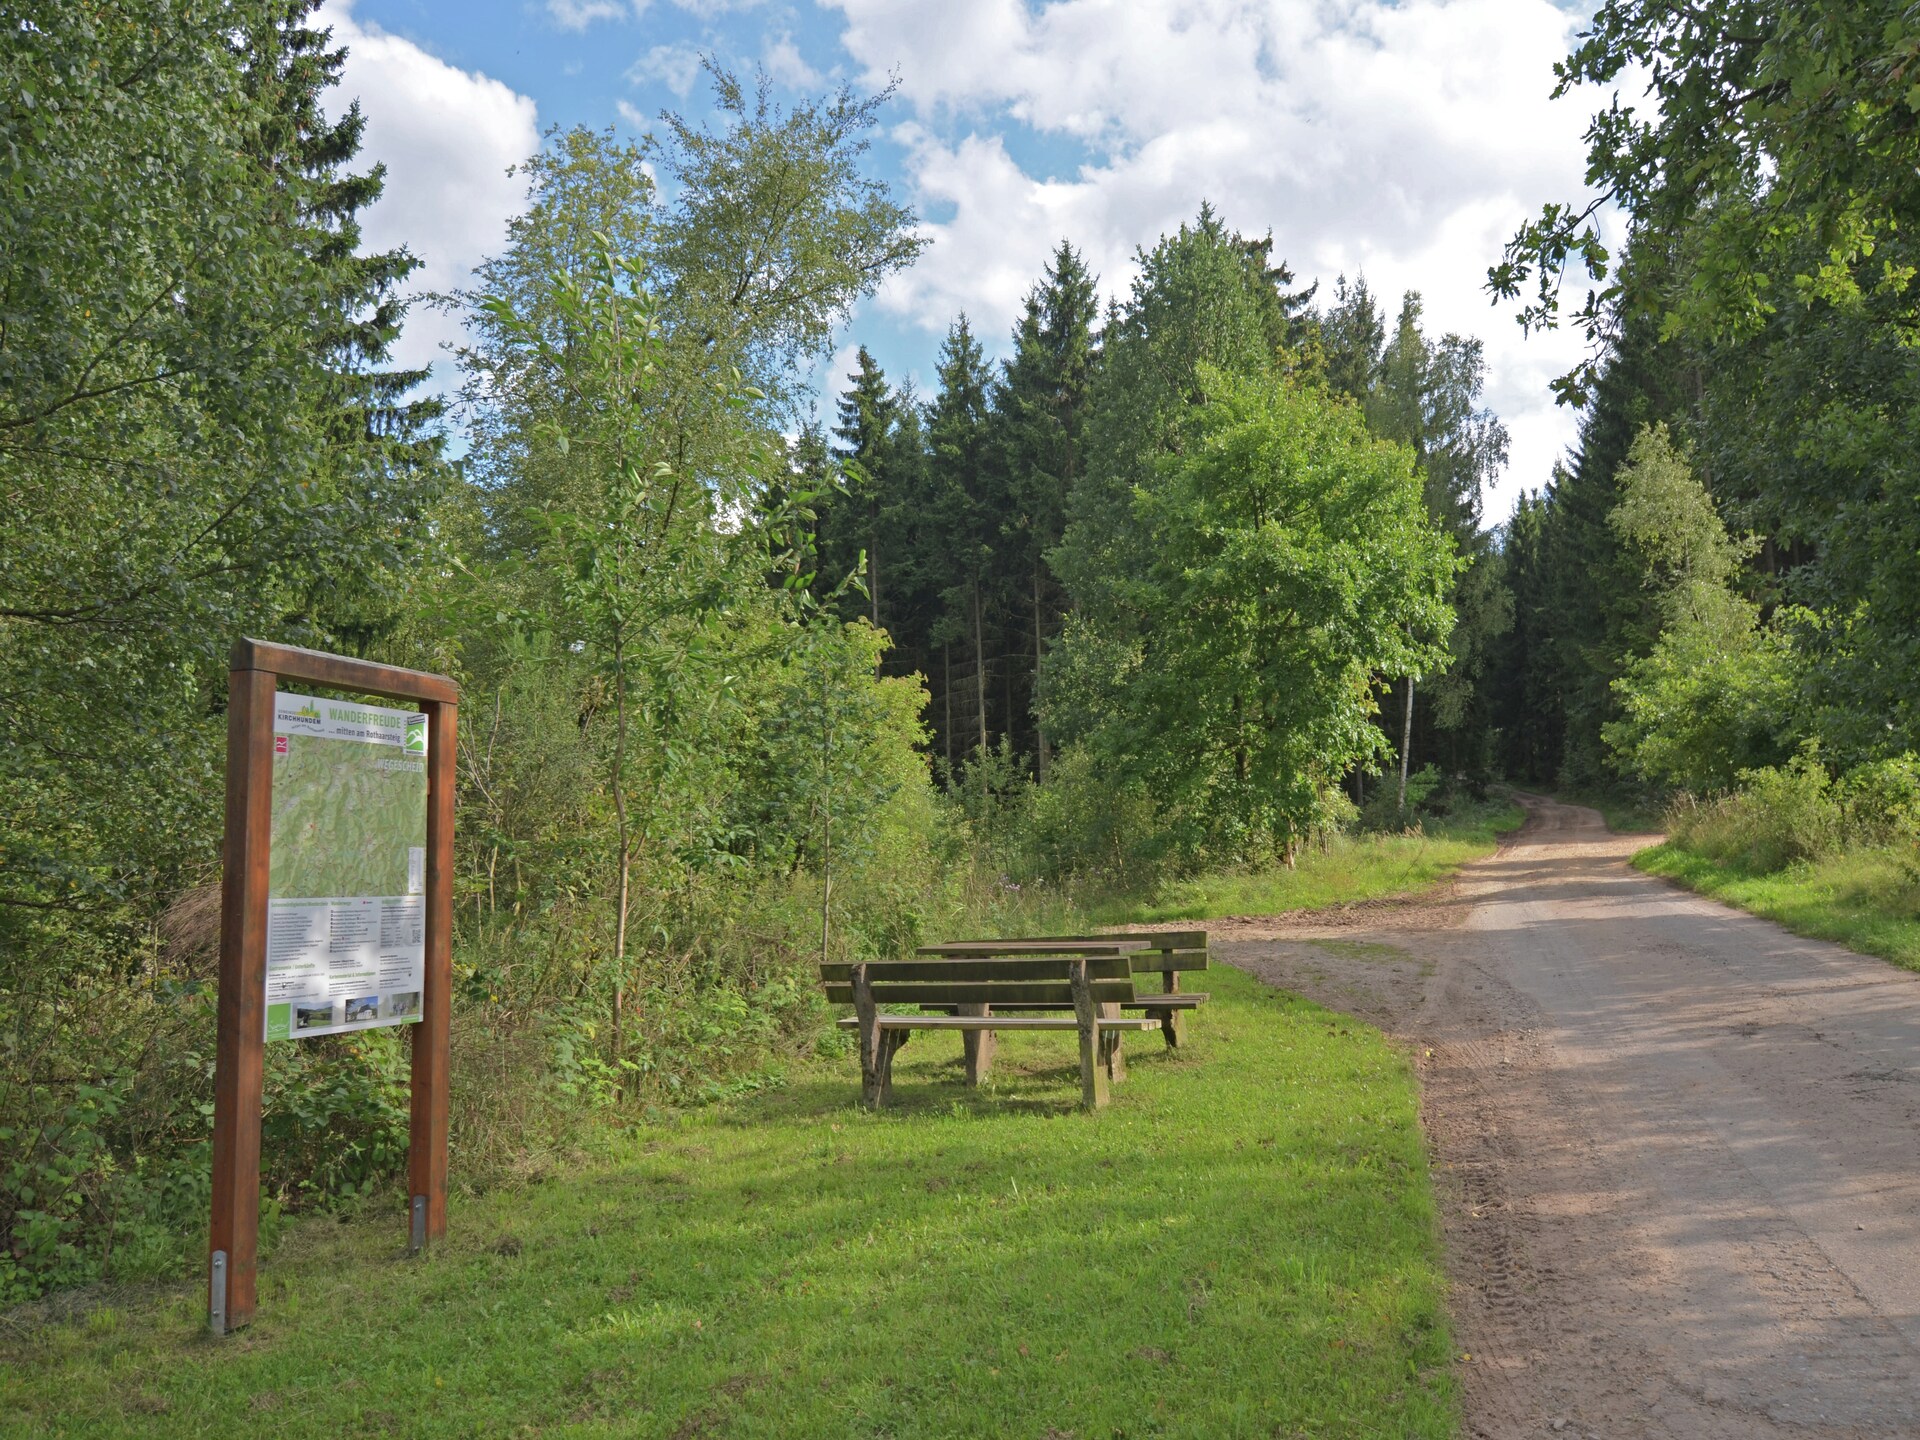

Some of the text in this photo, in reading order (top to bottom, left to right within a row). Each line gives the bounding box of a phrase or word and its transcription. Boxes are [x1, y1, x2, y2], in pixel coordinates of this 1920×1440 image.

[278, 714, 321, 724] KIRCHHUNDEM
[329, 708, 401, 728] WANDERFREUDE
[336, 727, 355, 735] mitten
[366, 730, 400, 743] Rothaarsteig
